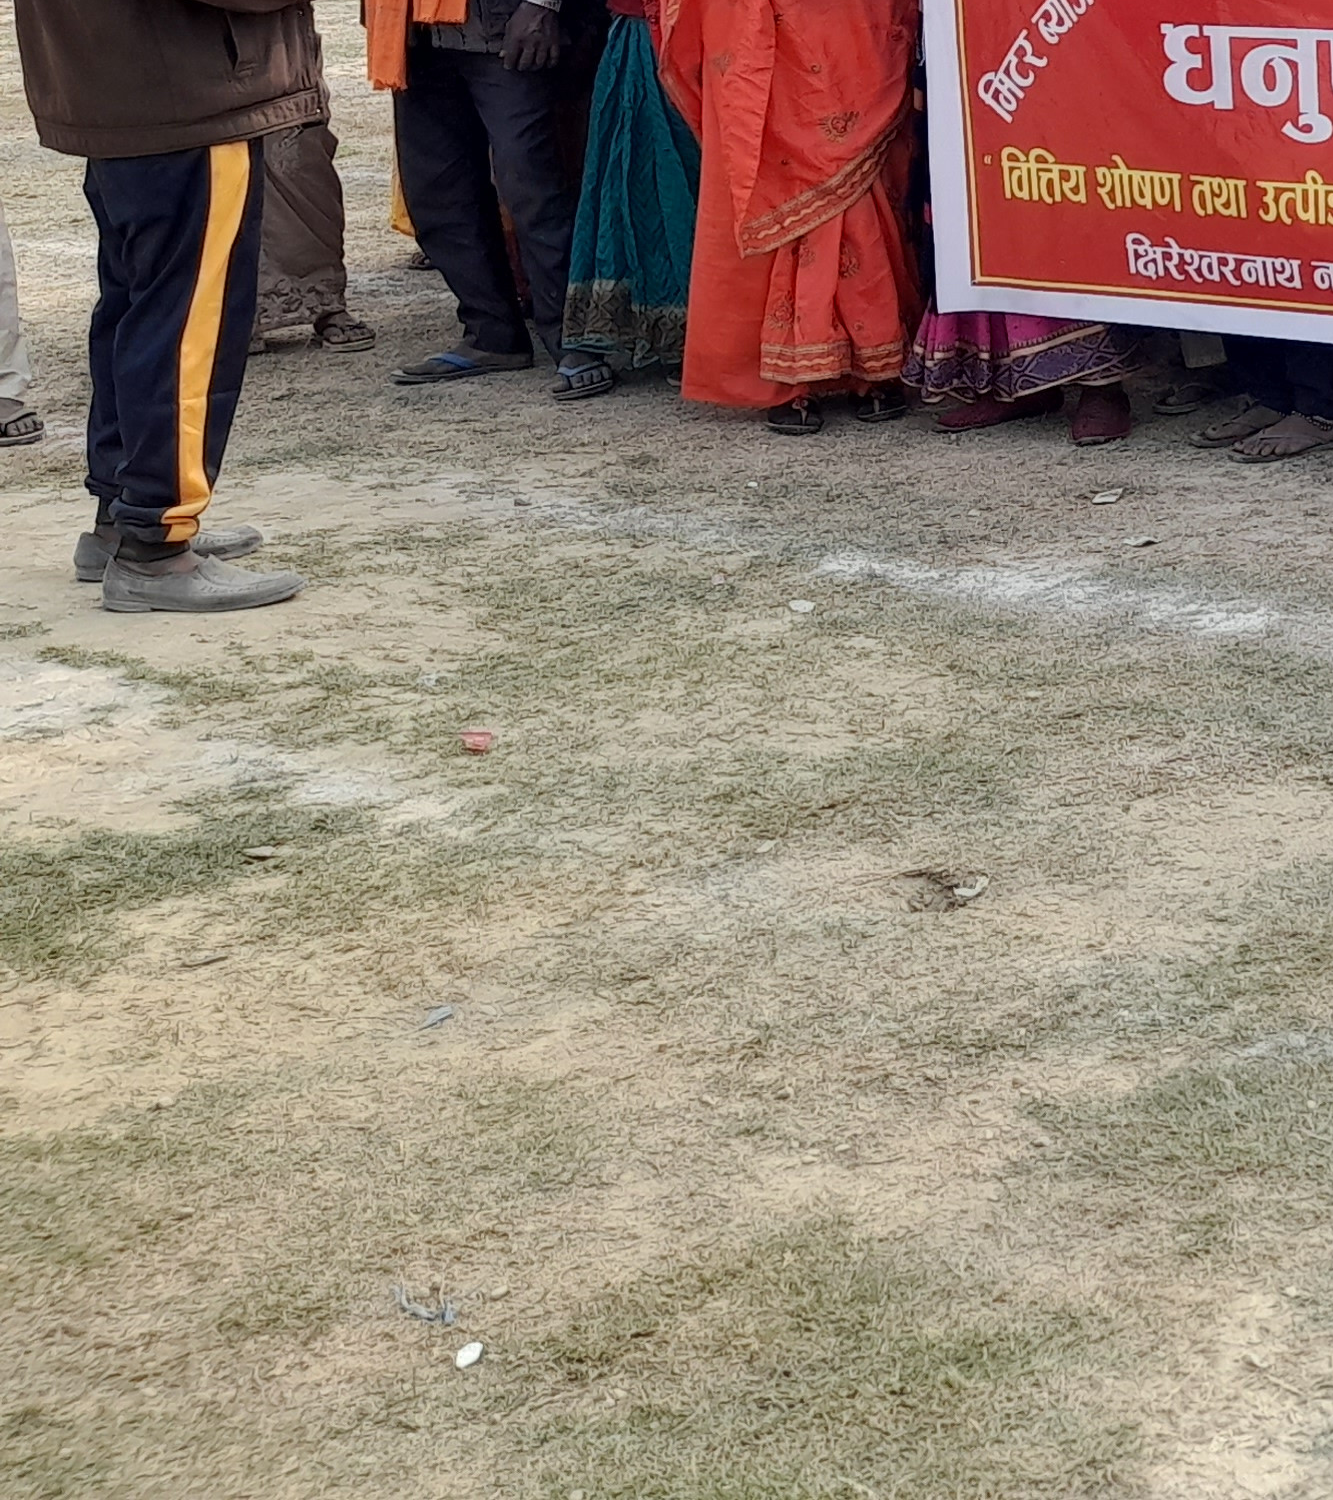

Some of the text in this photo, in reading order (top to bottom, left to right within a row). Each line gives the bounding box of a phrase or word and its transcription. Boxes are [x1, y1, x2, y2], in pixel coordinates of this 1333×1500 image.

[977, 29, 1048, 123] मिटर
[1000, 146, 1088, 205] वित्तिय
[1096, 154, 1182, 212] शोषण
[1190, 174, 1248, 218] तथा
[1126, 232, 1303, 290] क्षिरेश्वरनाथ
